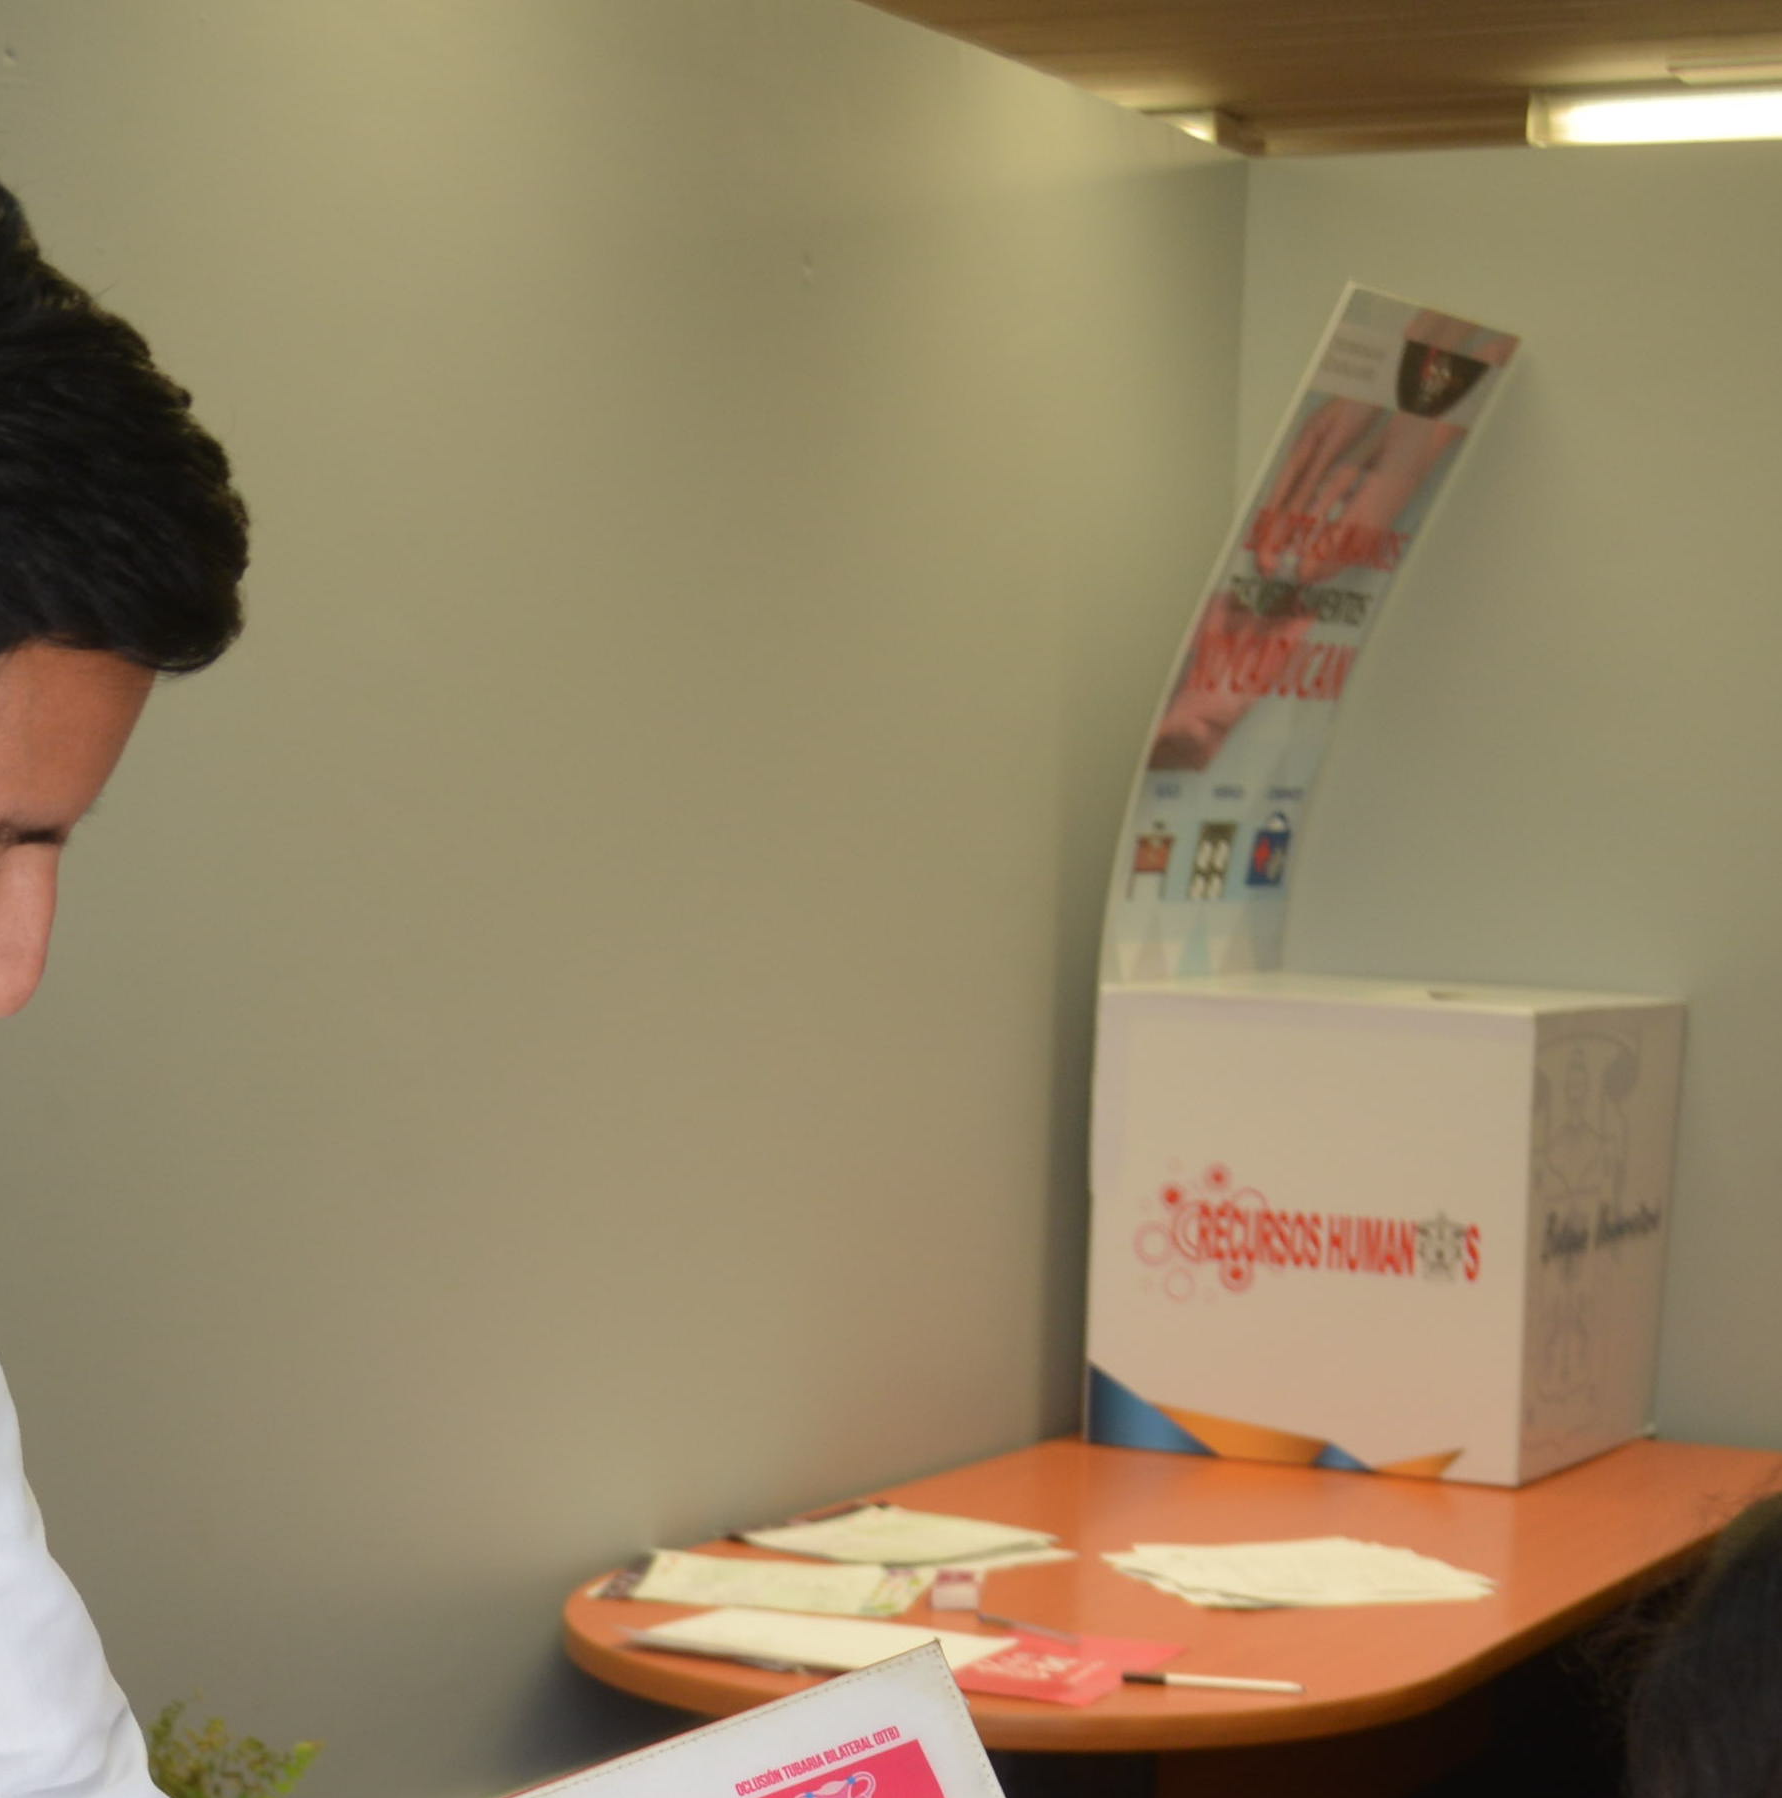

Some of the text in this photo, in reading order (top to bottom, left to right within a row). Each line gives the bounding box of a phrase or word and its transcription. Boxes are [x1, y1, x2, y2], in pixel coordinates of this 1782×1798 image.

[1196, 1205, 1323, 1270] RECURSOS
[735, 1725, 900, 1797] OCLUSIÓN TUBARIA BILATERAL (OTB)
